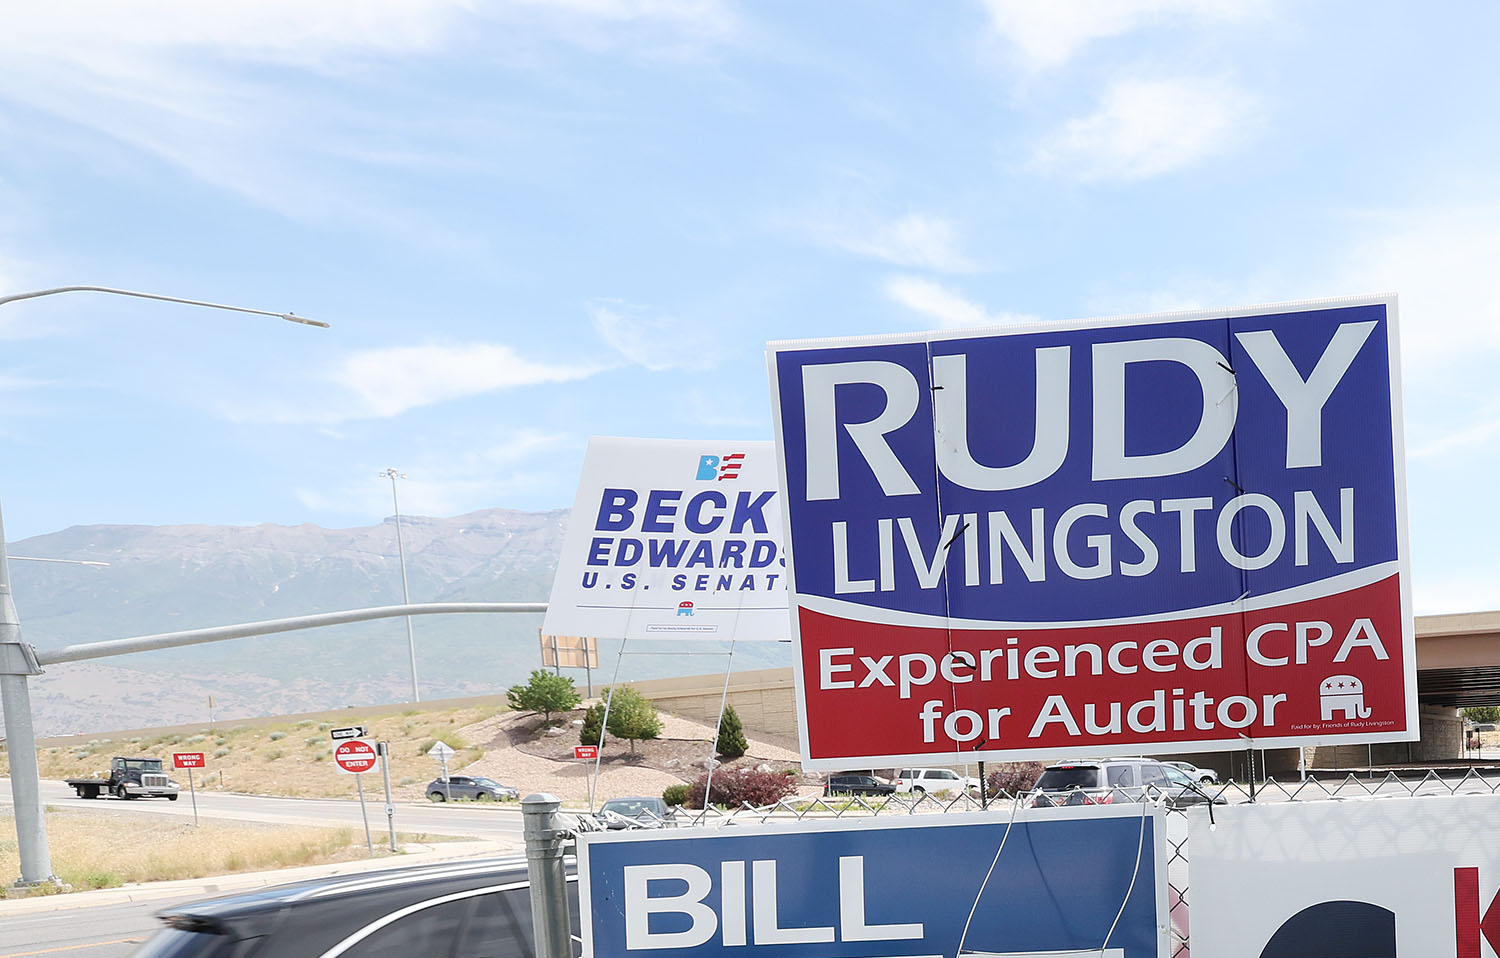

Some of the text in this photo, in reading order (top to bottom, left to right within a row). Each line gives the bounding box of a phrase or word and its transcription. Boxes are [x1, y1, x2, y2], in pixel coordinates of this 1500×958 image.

[800, 320, 1379, 501] RUDY
[582, 572, 789, 591] U.S. SENAT
[587, 537, 787, 569] EDWARD
[833, 487, 1355, 594] LIVINGSTON
[819, 617, 1390, 699] Experienced CPA
[918, 687, 1287, 743] for Auditor
[624, 856, 924, 951] BILL
